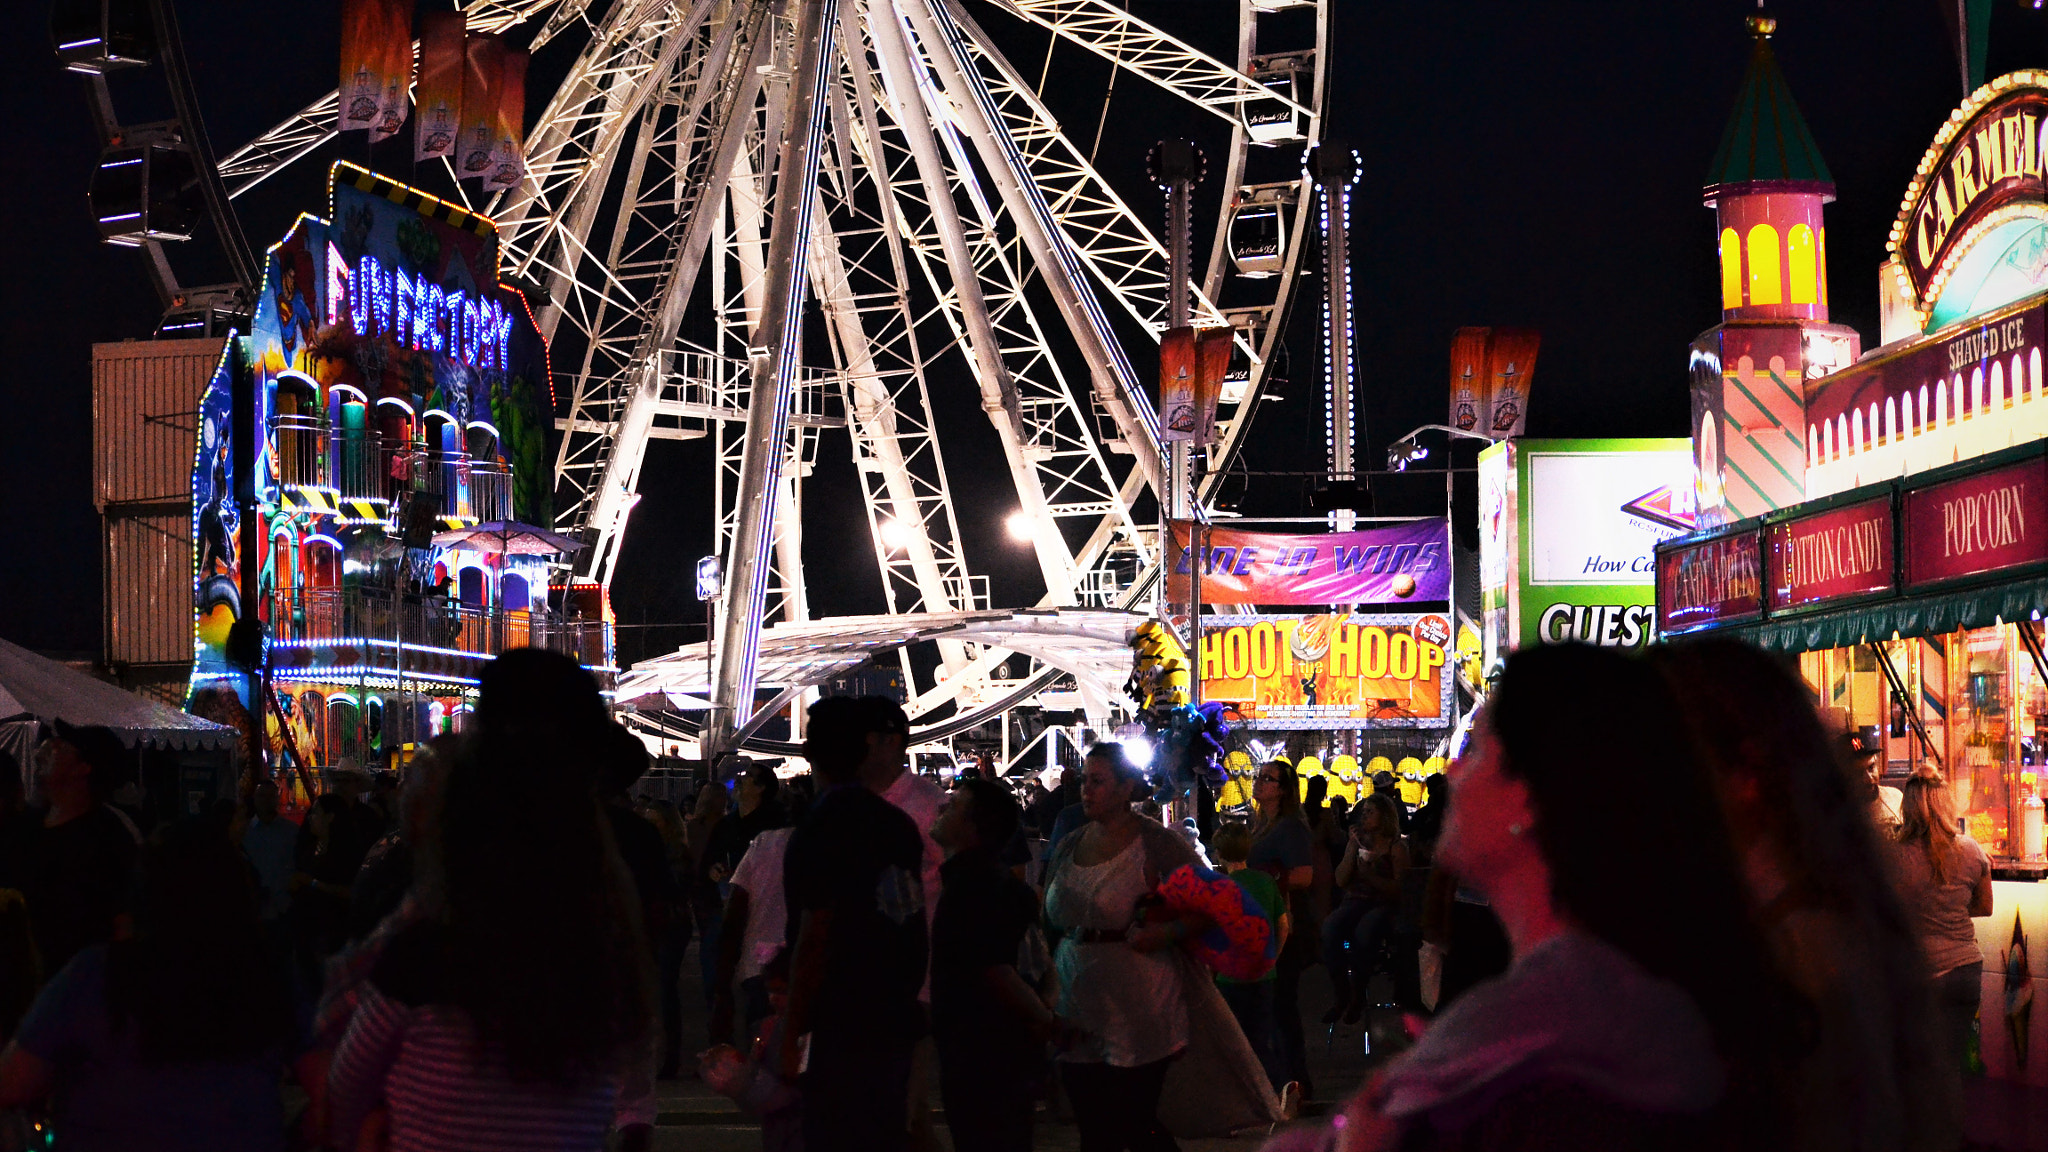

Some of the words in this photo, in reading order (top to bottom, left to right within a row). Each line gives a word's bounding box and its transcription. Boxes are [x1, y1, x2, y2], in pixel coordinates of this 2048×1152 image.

[327, 240, 393, 338] FUN
[396, 265, 514, 372] FACTORY
[1948, 327, 1999, 372] SHAVED
[2001, 317, 2025, 353] ICE
[1943, 483, 2025, 558] POPCORN
[1582, 554, 1627, 575] How
[1674, 556, 1712, 610] CANDY
[1711, 547, 1756, 603] APPLES
[1782, 528, 1835, 589] COTTON
[1837, 516, 1883, 579] CANDY
[1199, 619, 1300, 681] HOOT
[1329, 622, 1446, 682] HOOP
